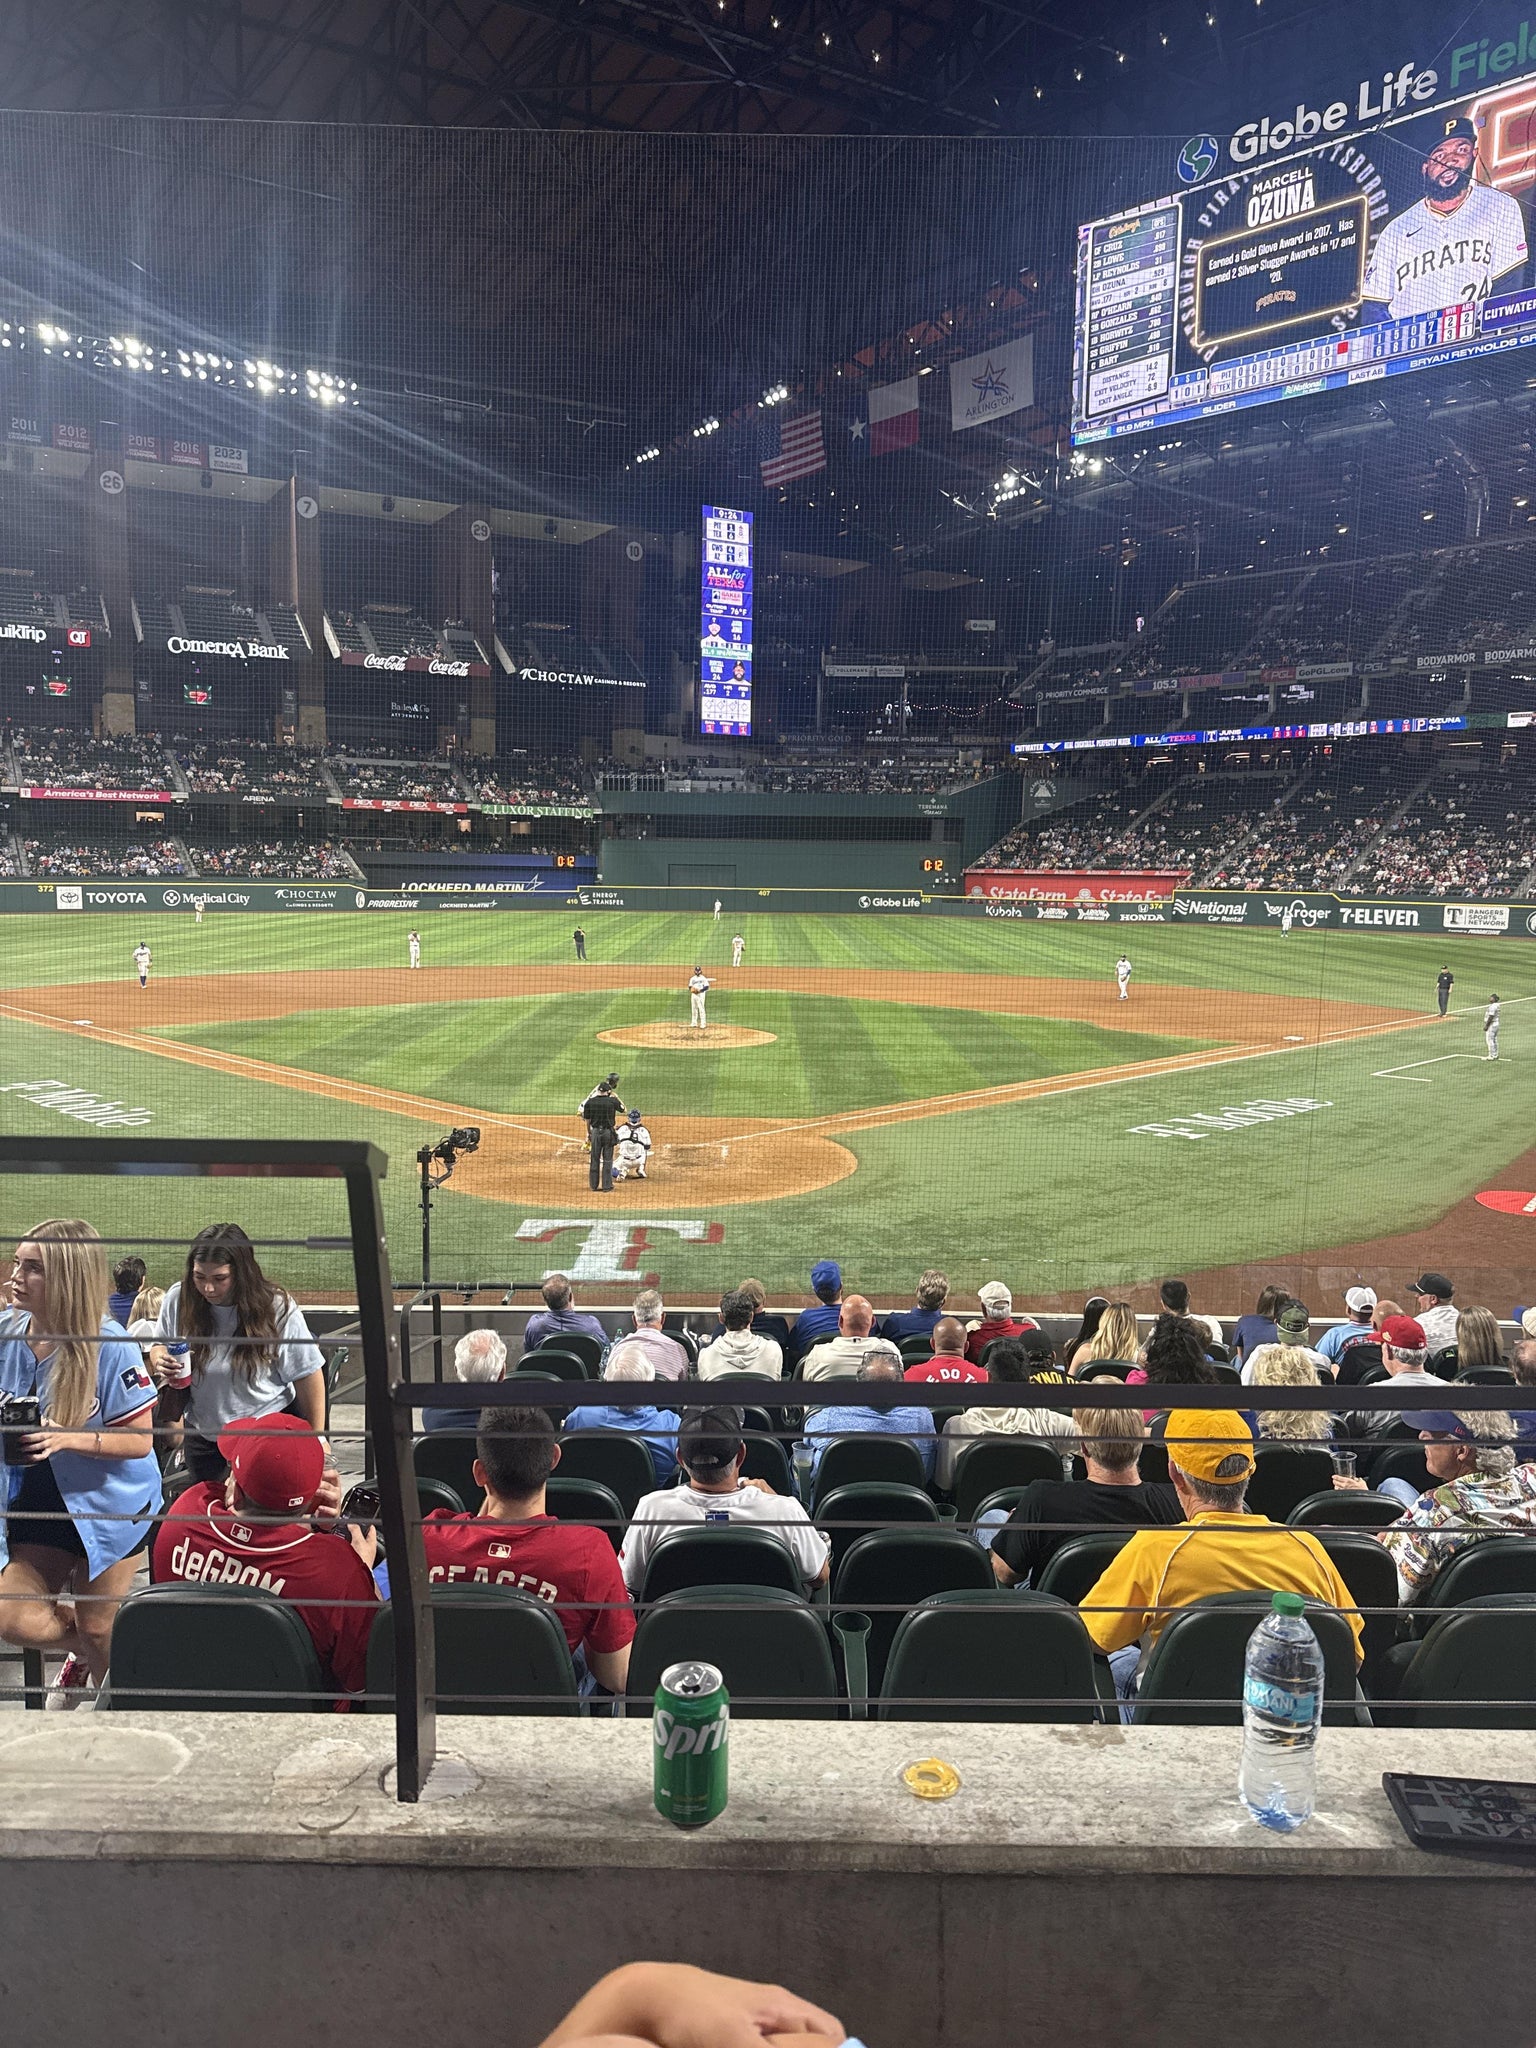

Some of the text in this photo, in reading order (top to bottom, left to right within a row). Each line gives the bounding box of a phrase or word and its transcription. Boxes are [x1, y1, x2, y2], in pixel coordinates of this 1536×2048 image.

[1229, 101, 1348, 163] Globe
[1357, 62, 1439, 117] Life
[1252, 166, 1313, 195] MARCELL
[1247, 178, 1316, 227] OZUNA
[1103, 241, 1123, 253] CRUZ
[1209, 253, 1234, 270] Earned
[1241, 246, 1257, 261] Gold
[1258, 241, 1278, 257] Glove
[1279, 233, 1304, 253] Award
[1305, 229, 1313, 242] in
[1314, 224, 1332, 241] 2017.
[1338, 219, 1354, 233] Has
[1103, 253, 1125, 265] LOWE
[1205, 233, 1356, 287] earned 2 Silver Slugger Awards in '17 and
[1396, 239, 1491, 292] PIRATES
[1102, 261, 1140, 276] REYNOLDS
[1102, 278, 1125, 292] OZUNA
[1101, 300, 1133, 316] O'HEARN
[1462, 303, 1474, 312] ABS
[1100, 312, 1138, 328] GONZALES
[1100, 325, 1134, 342] HORWITZ
[1090, 340, 1128, 358] SS GRIFFIN
[1099, 355, 1119, 367] BART
[1102, 362, 1158, 384] DISTANCE 14.2
[1221, 370, 1232, 380] PIT
[1094, 372, 1155, 397] EXIT VELOCITY 72
[1134, 419, 1154, 430] MPH
[1202, 401, 1236, 414] SLIDER
[1284, 379, 1322, 394] National
[1350, 369, 1371, 381] LAST
[1371, 367, 1384, 377] AB
[1410, 352, 1450, 368] BRYAN
[1451, 338, 1518, 359] REYNOLDS
[1219, 383, 1231, 392] TEX
[1098, 397, 1112, 406] EXIT
[1113, 391, 1133, 402] ANGLE
[965, 395, 1015, 418] ARLINGTON
[11, 417, 37, 431] 2011
[59, 425, 87, 439] 2012
[128, 435, 155, 448] 2015
[173, 441, 200, 455] 2016
[214, 446, 242, 460] 2023
[103, 476, 121, 489] 26
[303, 501, 312, 514] 7
[473, 525, 488, 537] 29
[629, 546, 640, 557] 10
[708, 566, 746, 584] ALL for
[708, 576, 745, 589] TEXAS
[0, 624, 47, 643] uikTrip
[70, 631, 87, 644] QT
[248, 644, 289, 659] Bank
[1417, 653, 1476, 666] BODYARMOR
[1299, 666, 1350, 678] GoPGL.com
[1363, 662, 1387, 673] PGL
[528, 667, 594, 686] CHOCTAW
[1270, 670, 1293, 681] PGL
[1153, 679, 1178, 690] 105.3
[1045, 686, 1109, 699] PRIORITY COMMERCE
[1144, 736, 1160, 744] ALL
[1169, 734, 1196, 742] TEXAS
[1015, 744, 1044, 752] CUTWATER
[44, 789, 160, 800] America's Best Network
[494, 805, 592, 818] LUXOR STAFFING
[37, 885, 55, 893] 372
[401, 882, 525, 892] LOCKHEED MARTIN
[86, 892, 147, 904] TOYOTA
[182, 893, 250, 906] Medical City
[281, 889, 337, 899] CHOCTAW
[367, 899, 420, 909] PROGRESSIVE
[593, 898, 624, 906] TRANSFER
[872, 897, 920, 908] Globe Life
[1188, 900, 1247, 916] National
[985, 905, 1023, 917] Kubota
[1284, 900, 1331, 927] Kroger
[1447, 908, 1463, 925] T
[1119, 914, 1165, 922] HONDA
[1222, 915, 1244, 923] Rental
[171, 1536, 286, 1596] deGROM
